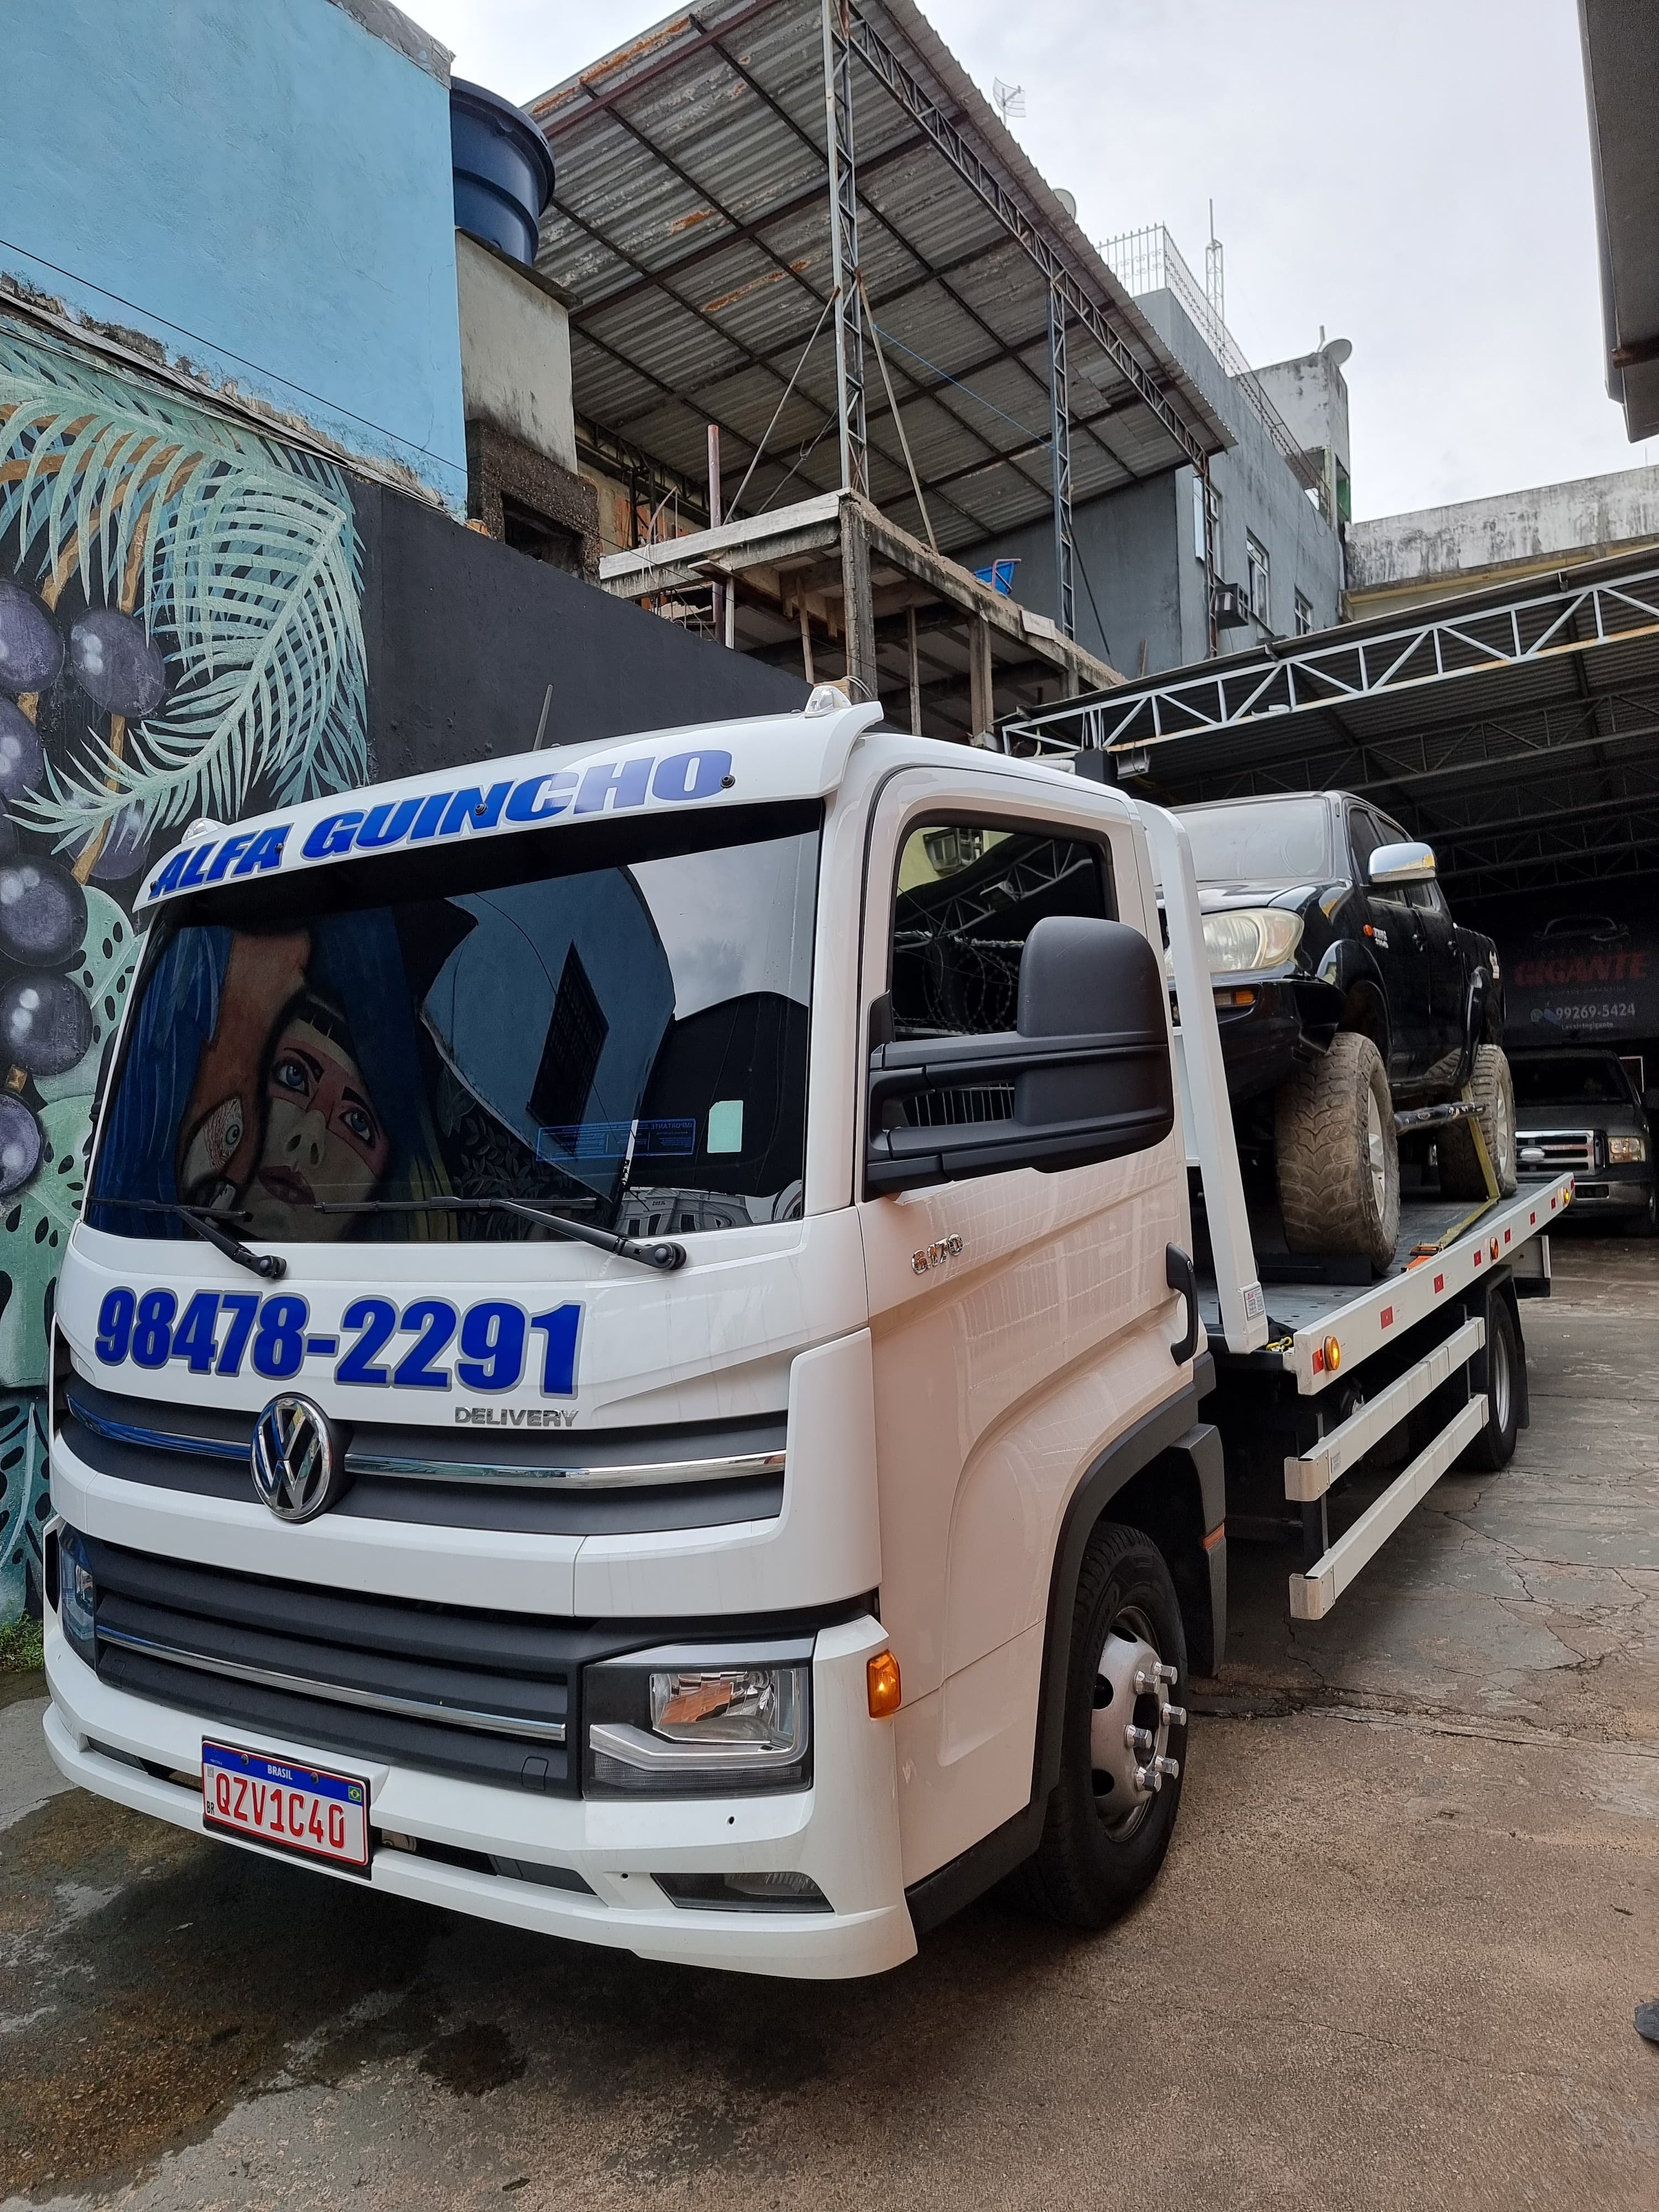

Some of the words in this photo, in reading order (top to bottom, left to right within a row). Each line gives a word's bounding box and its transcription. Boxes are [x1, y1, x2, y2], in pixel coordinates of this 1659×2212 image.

[146, 822, 294, 901] ALFA
[300, 749, 733, 862] GUINCHO
[911, 1233, 964, 1275] 6.170
[94, 1285, 586, 1400] 98478-2291
[453, 1406, 580, 1428] DELIVERY
[267, 1764, 293, 1781] BRASIL
[206, 1800, 215, 1815] BR
[216, 1772, 345, 1849] QZV1C40
